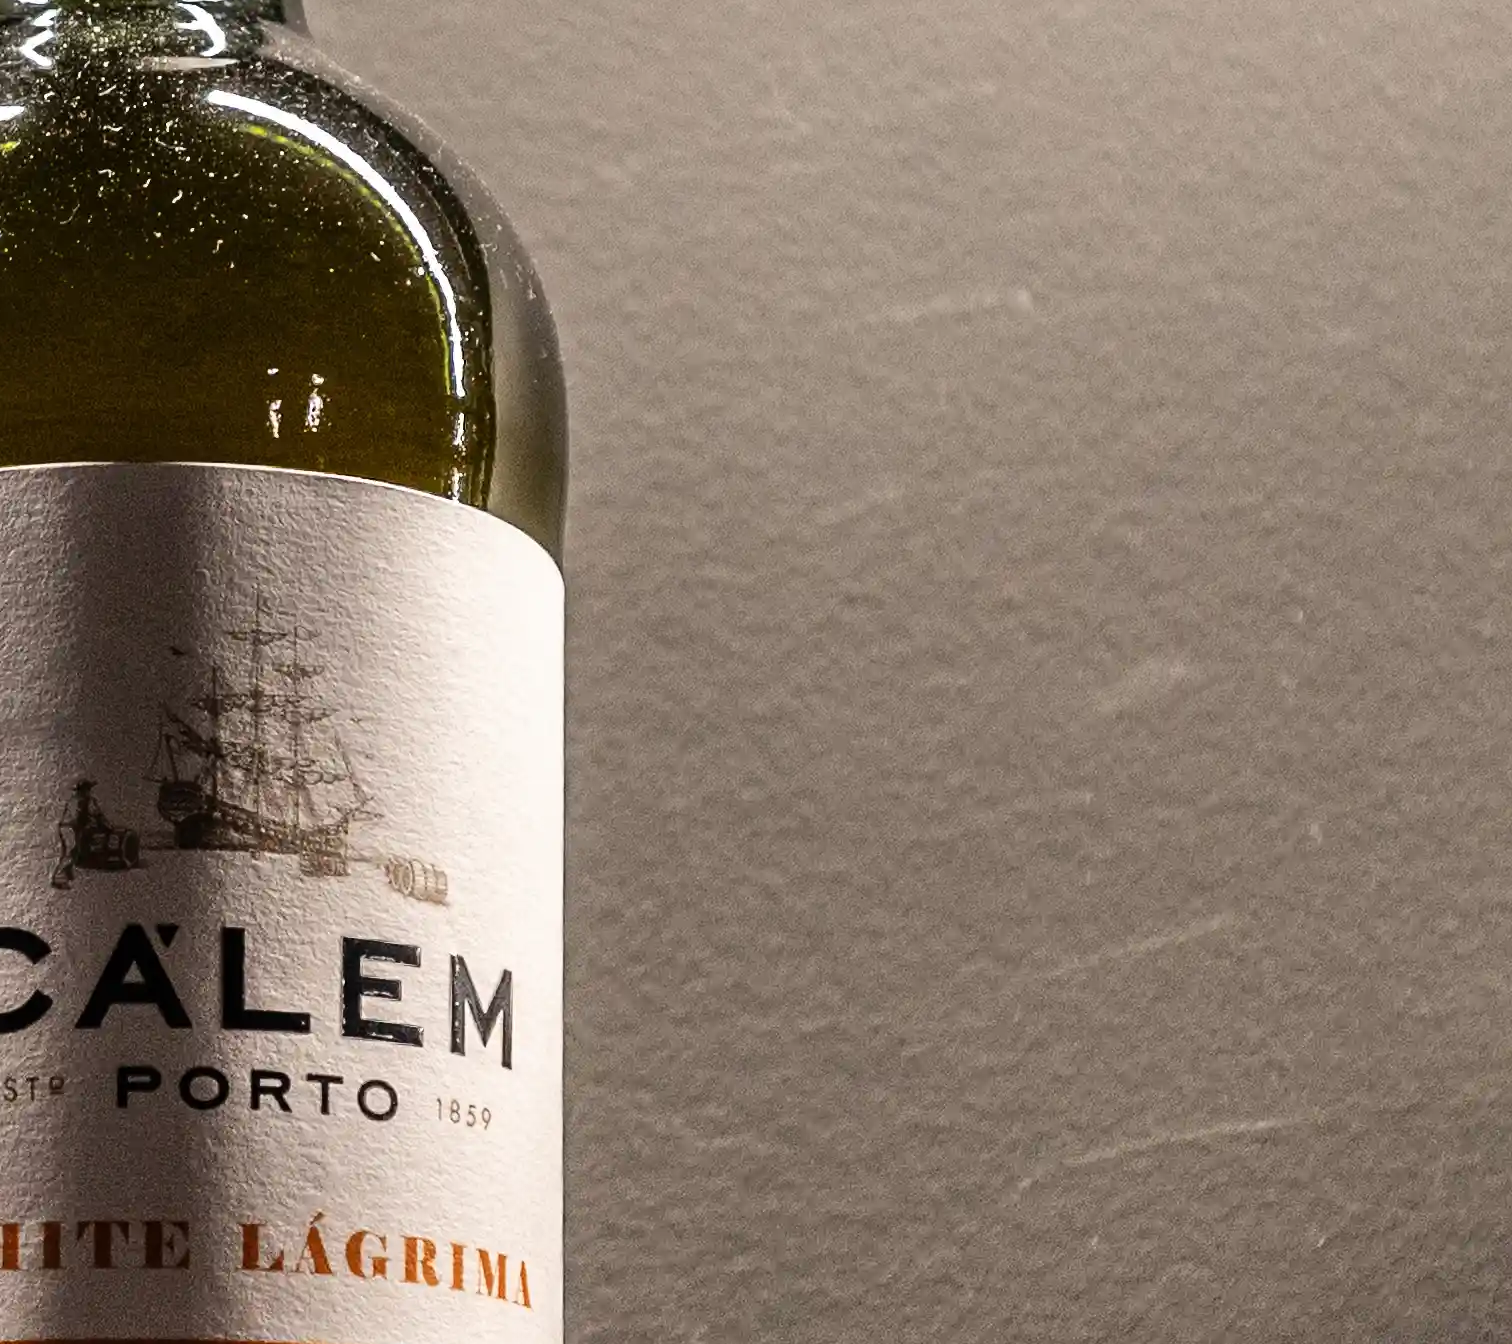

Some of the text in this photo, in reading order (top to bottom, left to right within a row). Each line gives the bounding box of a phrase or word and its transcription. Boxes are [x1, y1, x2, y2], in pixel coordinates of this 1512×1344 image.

[114, 1064, 400, 1123] PORTO
[435, 1096, 494, 1133] 1859
[238, 1211, 535, 1311] LÁGRIMA
